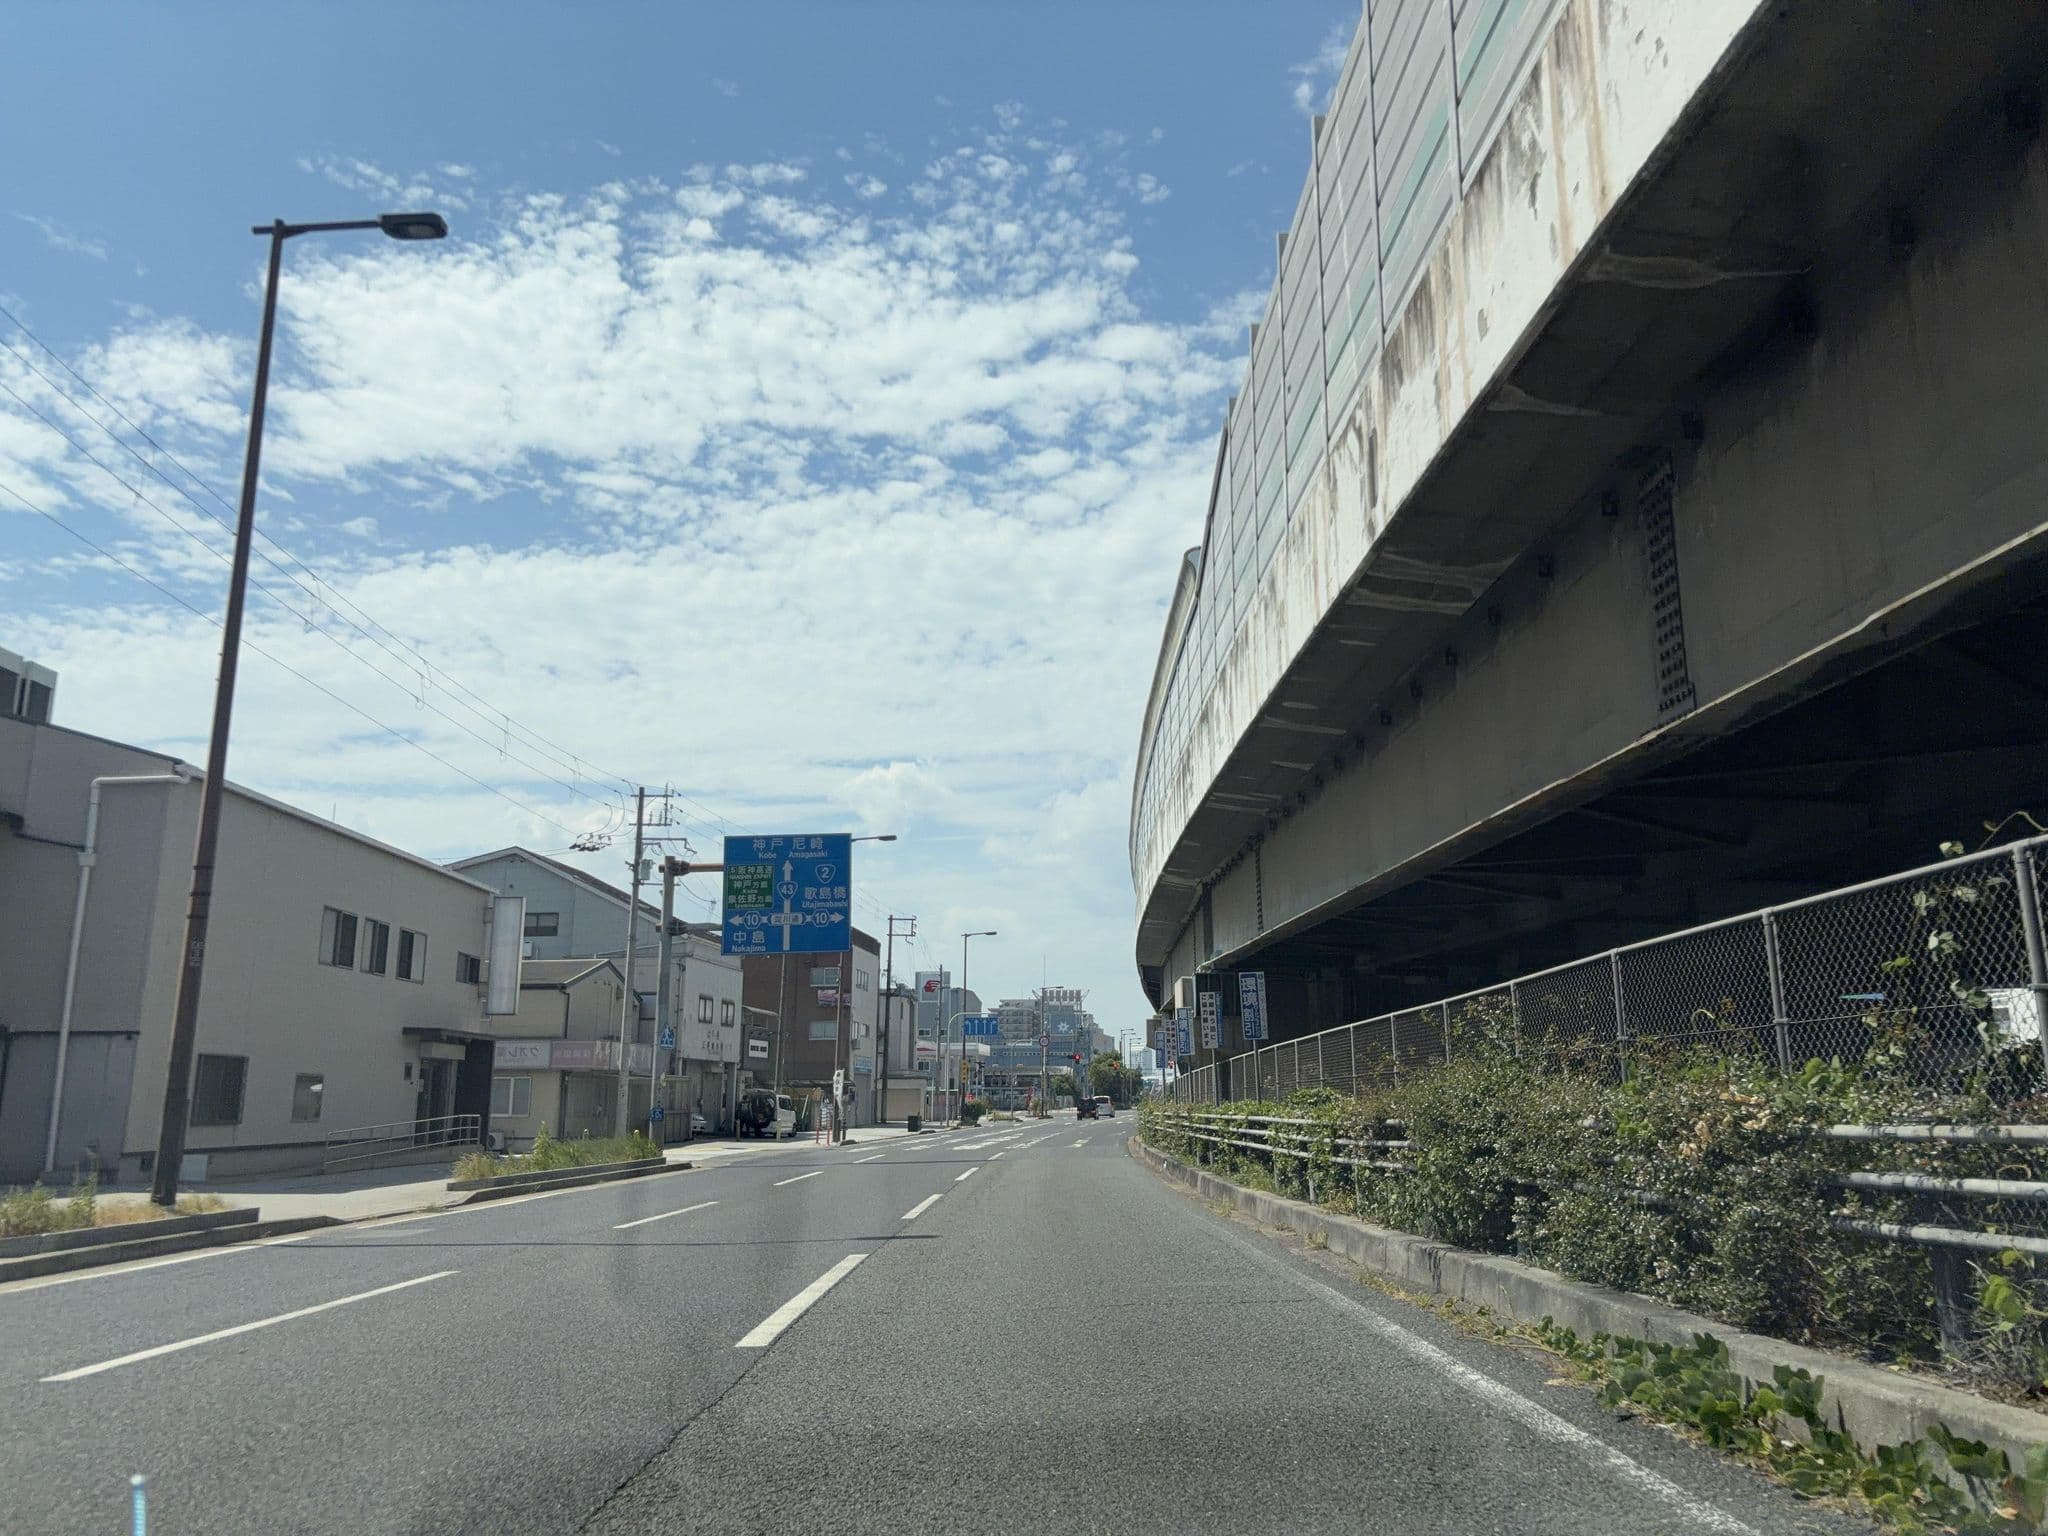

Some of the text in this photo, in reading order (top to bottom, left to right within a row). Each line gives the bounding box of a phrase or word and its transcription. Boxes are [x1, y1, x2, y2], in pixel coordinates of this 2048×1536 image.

[753, 837, 823, 851] 神戸 尼崎
[758, 851, 828, 860] Kobe Amagasaki
[821, 867, 830, 878] 2
[781, 885, 794, 895] 43
[804, 886, 848, 900] 歌島橋
[746, 914, 759, 926] 10
[815, 912, 828, 924] 10
[733, 931, 765, 944] 中島
[731, 944, 766, 953] Nakajima
